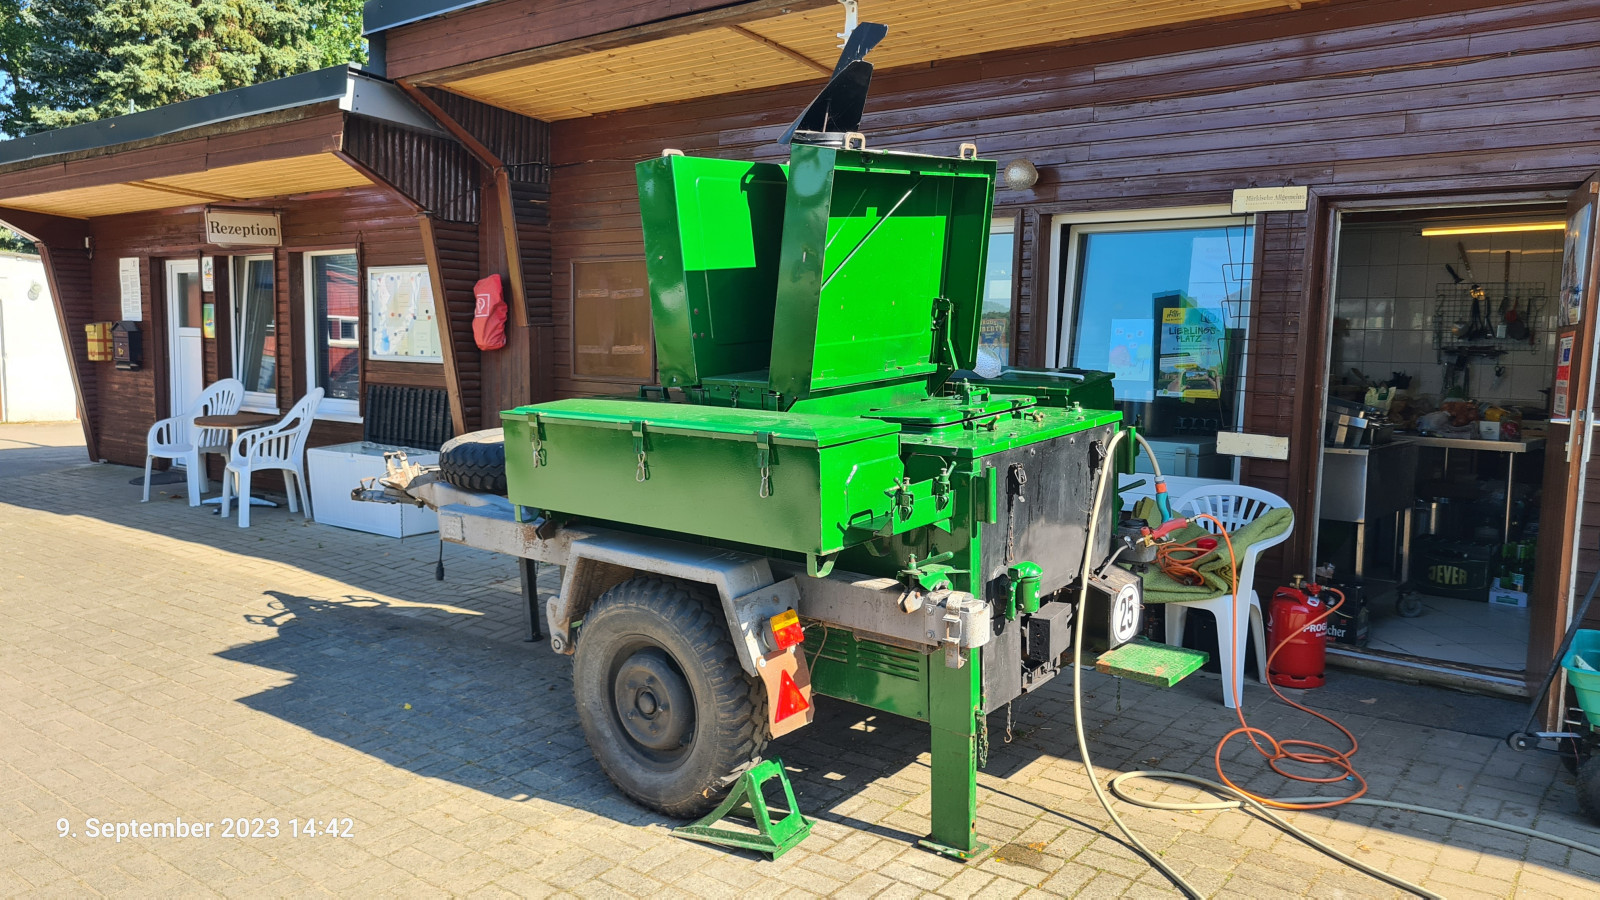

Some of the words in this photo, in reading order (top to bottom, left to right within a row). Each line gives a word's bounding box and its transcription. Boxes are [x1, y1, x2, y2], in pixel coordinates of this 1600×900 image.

[210, 221, 277, 238] Rezeption
[1176, 335, 1202, 343] PLATZ
[1428, 565, 1468, 585] JEVER
[1120, 594, 1134, 633] 25
[1303, 621, 1327, 632] PROG
